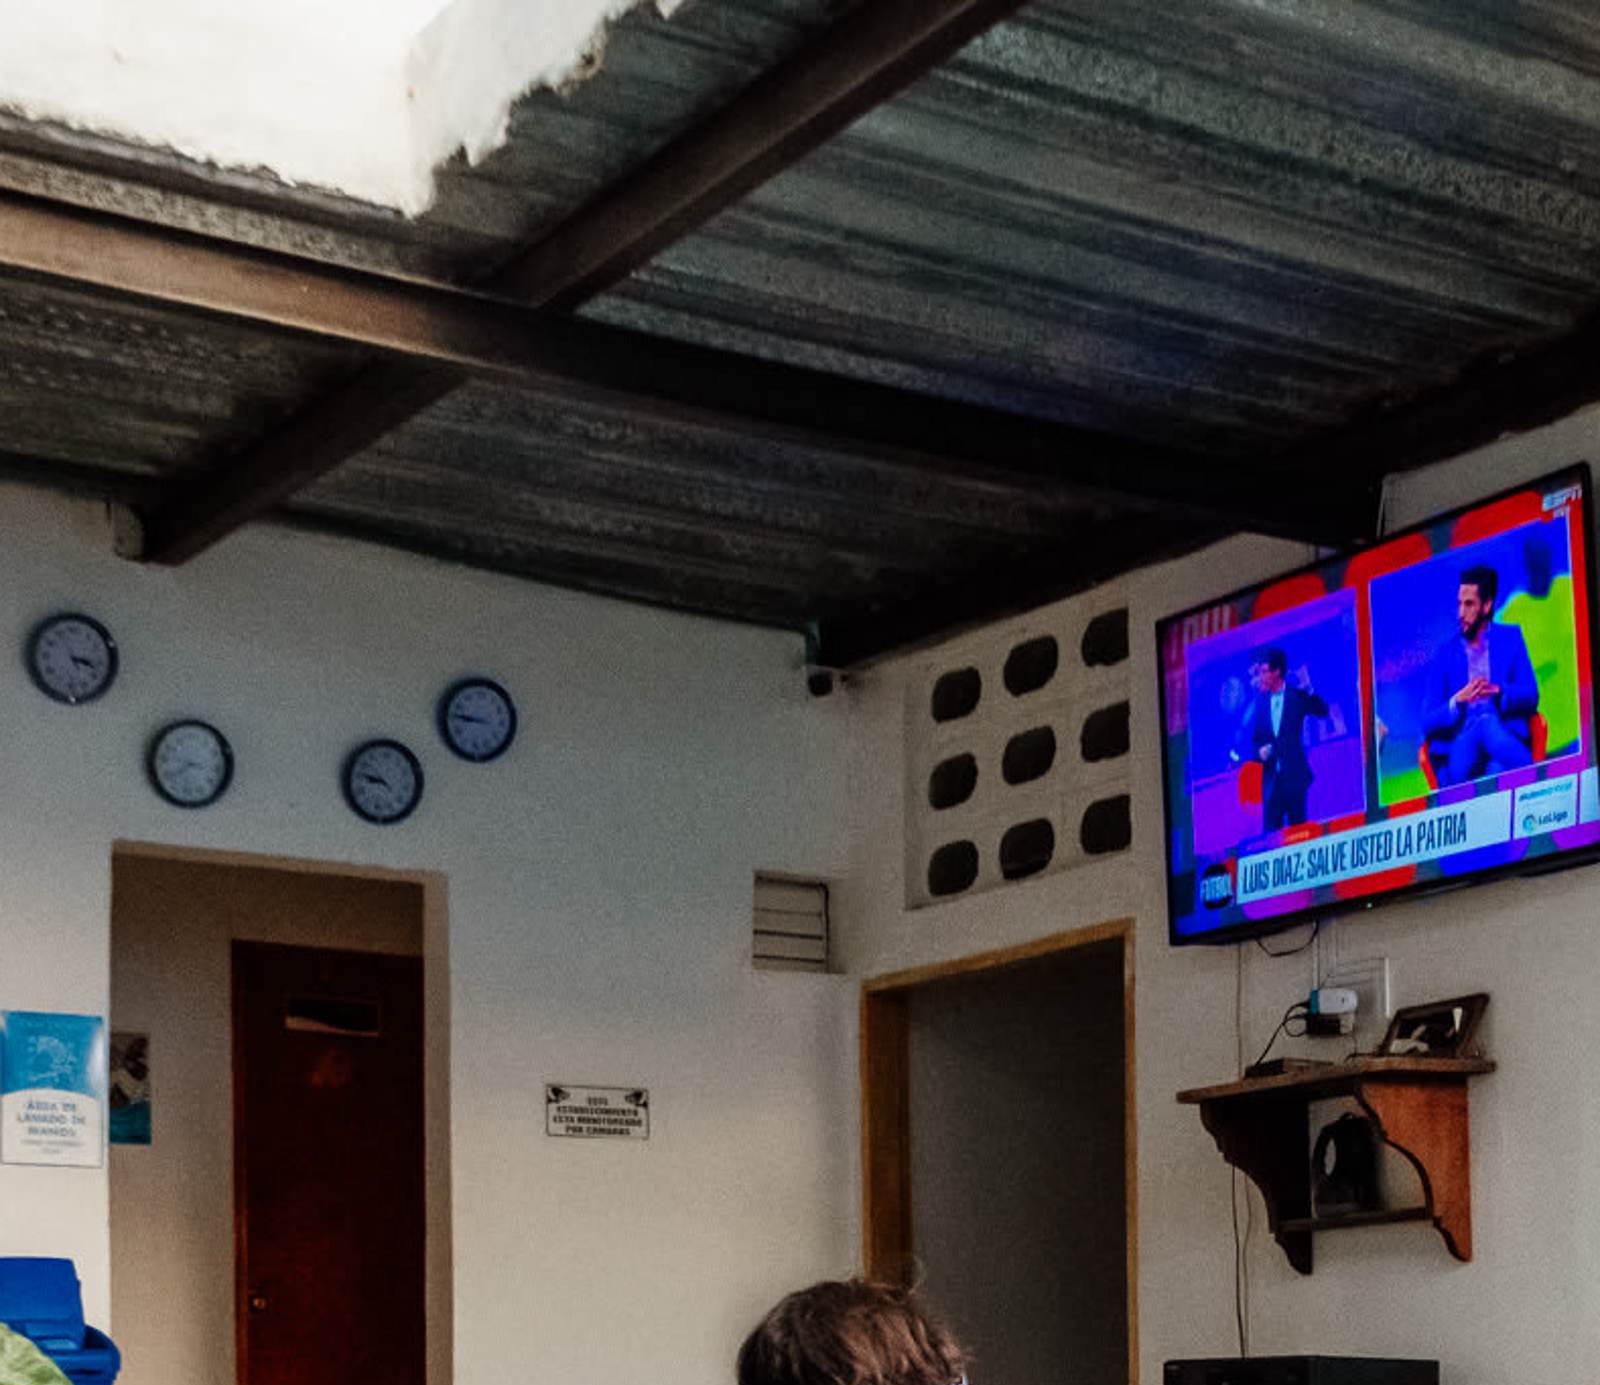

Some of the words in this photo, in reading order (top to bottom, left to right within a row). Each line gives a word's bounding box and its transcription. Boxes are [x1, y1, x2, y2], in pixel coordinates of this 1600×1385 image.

[1243, 861, 1270, 895] LUIS
[1307, 841, 1348, 879] SALVE
[1351, 829, 1394, 869] USTED
[1396, 825, 1413, 857] LA
[1416, 811, 1467, 853] PATRIA
